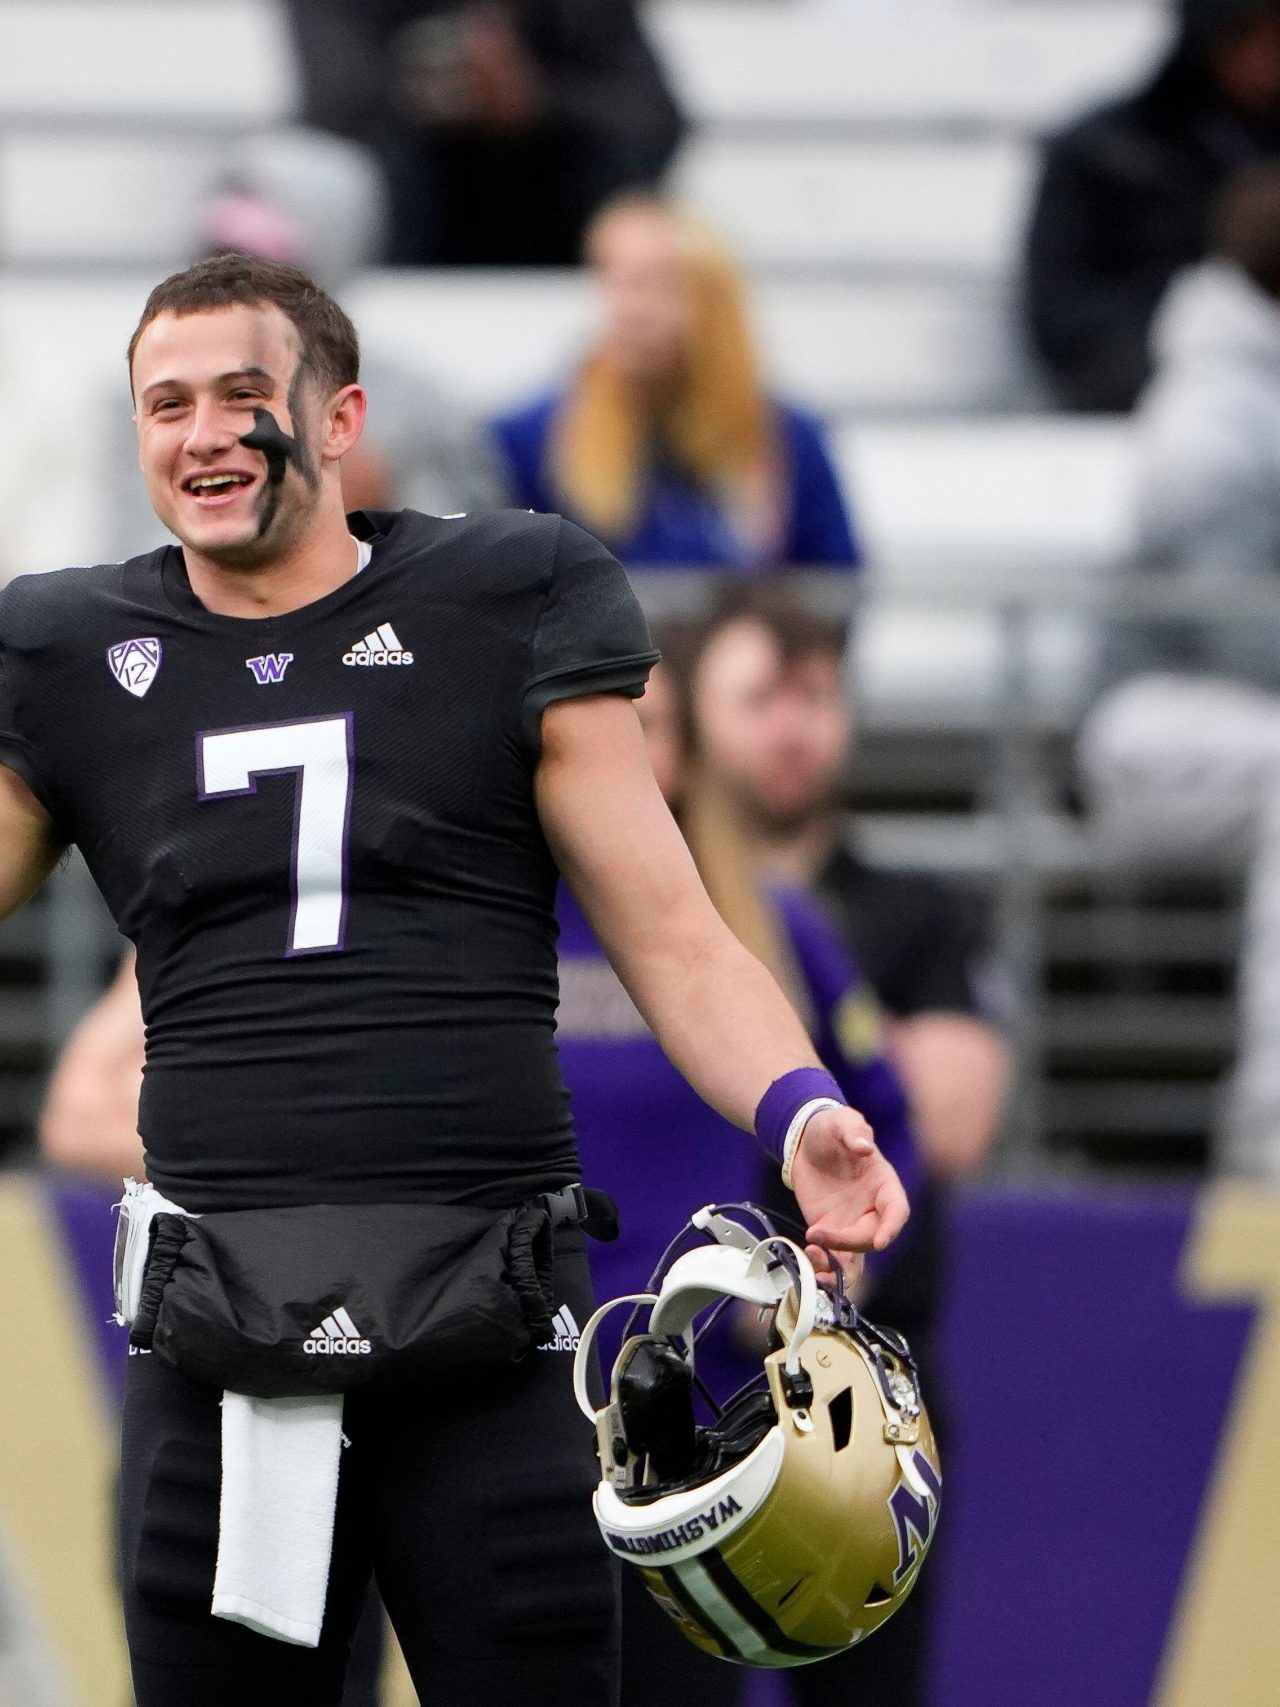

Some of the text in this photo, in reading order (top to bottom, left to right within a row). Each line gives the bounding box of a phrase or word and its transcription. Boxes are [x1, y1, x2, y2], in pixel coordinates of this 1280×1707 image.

[245, 652, 294, 684] W
[342, 649, 414, 666] adidas
[124, 662, 150, 688] 12
[195, 711, 354, 958] 7
[303, 1336, 371, 1355] adidas
